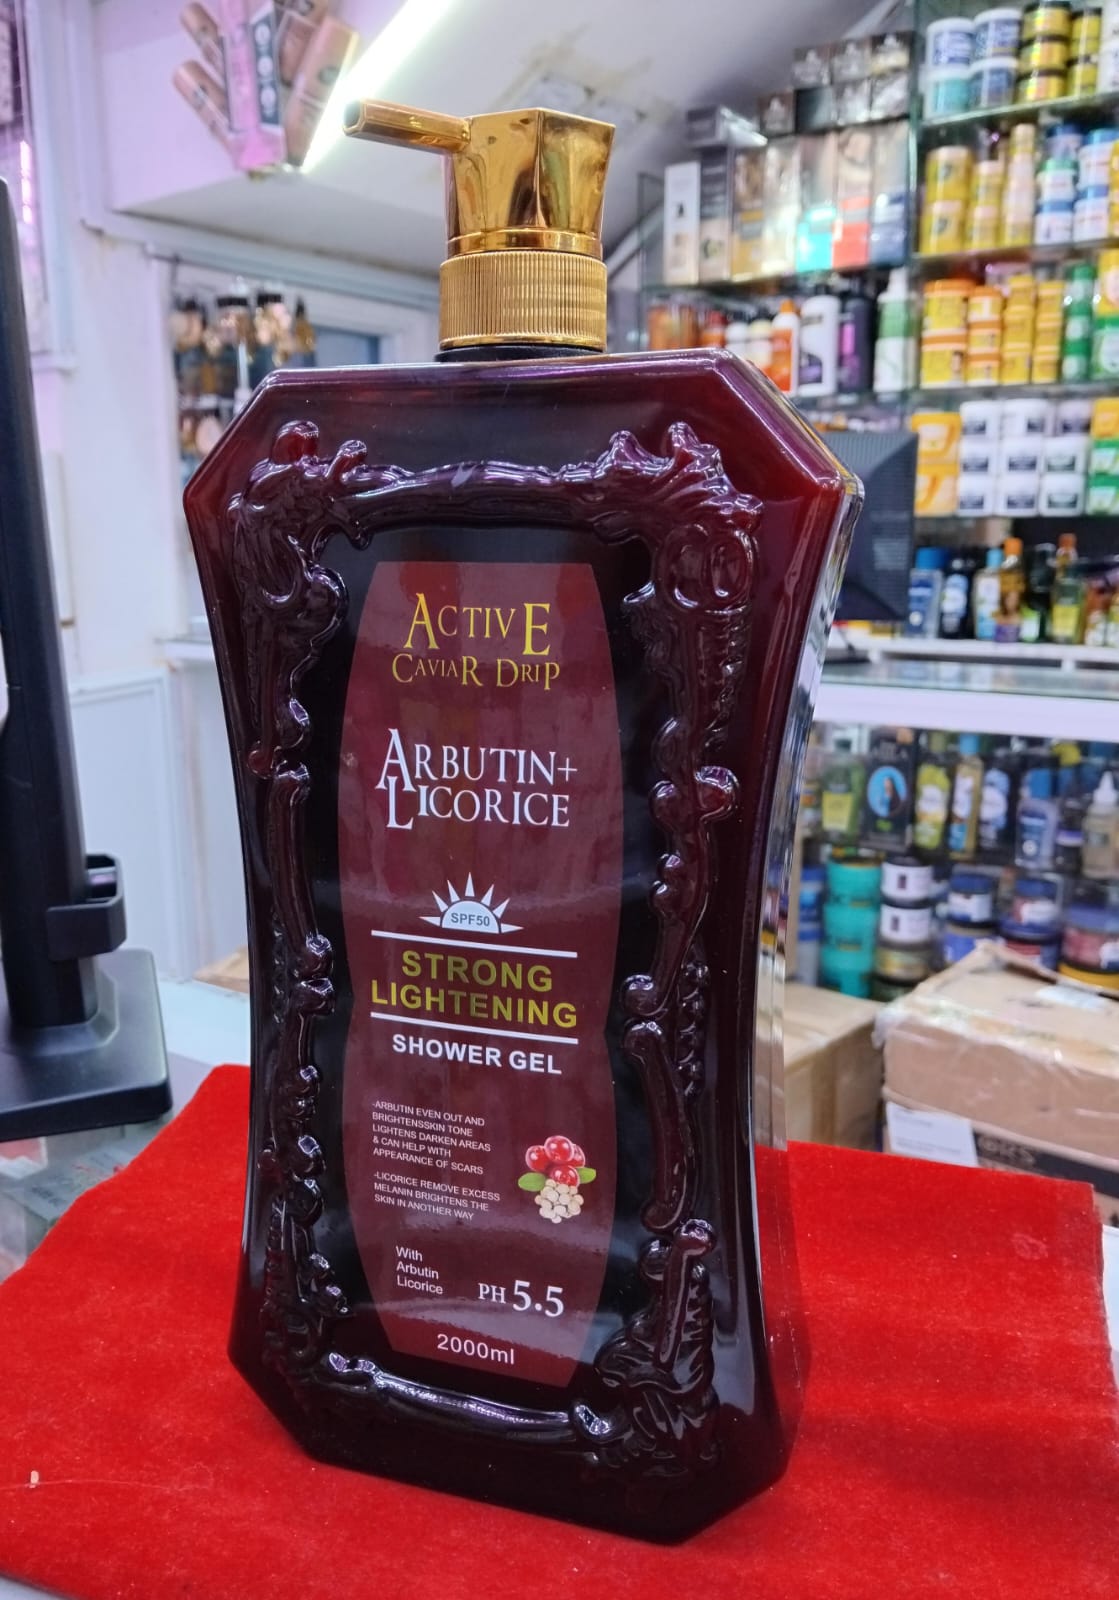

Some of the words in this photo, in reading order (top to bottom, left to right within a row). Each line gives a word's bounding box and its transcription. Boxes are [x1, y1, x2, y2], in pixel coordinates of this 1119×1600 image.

[403, 592, 550, 656] ACTIVE
[392, 653, 483, 687] CAVIAR
[496, 658, 560, 690] DRIP
[375, 728, 578, 792] ARBUTIN+
[386, 776, 570, 829] LICORICE
[450, 912, 490, 927] SPF50
[402, 950, 552, 992] STRONG
[371, 979, 577, 1028] LIGHTENING
[392, 1034, 502, 1067] SHOWER
[508, 1051, 562, 1075] GEL
[416, 1107, 441, 1120] EVEN
[443, 1112, 463, 1123] OUT
[464, 1116, 485, 1127] AND
[448, 1125, 473, 1137] TONE
[372, 1123, 417, 1139] LIGHTENS
[419, 1132, 457, 1147] DARKEN
[459, 1139, 491, 1152] AREAS
[373, 1135, 379, 1144] &
[381, 1137, 400, 1148] CAN
[402, 1140, 426, 1152] HELP
[427, 1146, 451, 1158] WITH
[373, 1147, 433, 1166] APPEARANCE
[435, 1159, 449, 1169] OF
[451, 1162, 484, 1175] SCARS
[374, 1182, 413, 1197] MELANIN
[415, 1190, 468, 1208] BRIGHTENS
[470, 1200, 489, 1212] THE
[420, 1179, 460, 1194] REMOVE
[462, 1187, 501, 1202] EXCESS
[374, 1193, 395, 1205] SKIN
[397, 1198, 406, 1208] IN
[407, 1201, 452, 1216] ANOTHER
[453, 1209, 475, 1220] WAY
[396, 1245, 423, 1262] With
[396, 1261, 439, 1280] Arbutin
[397, 1274, 444, 1295] Licorice
[478, 1282, 507, 1304] PH
[512, 1279, 564, 1317] 5.5
[437, 1333, 515, 1365] 2000ml
